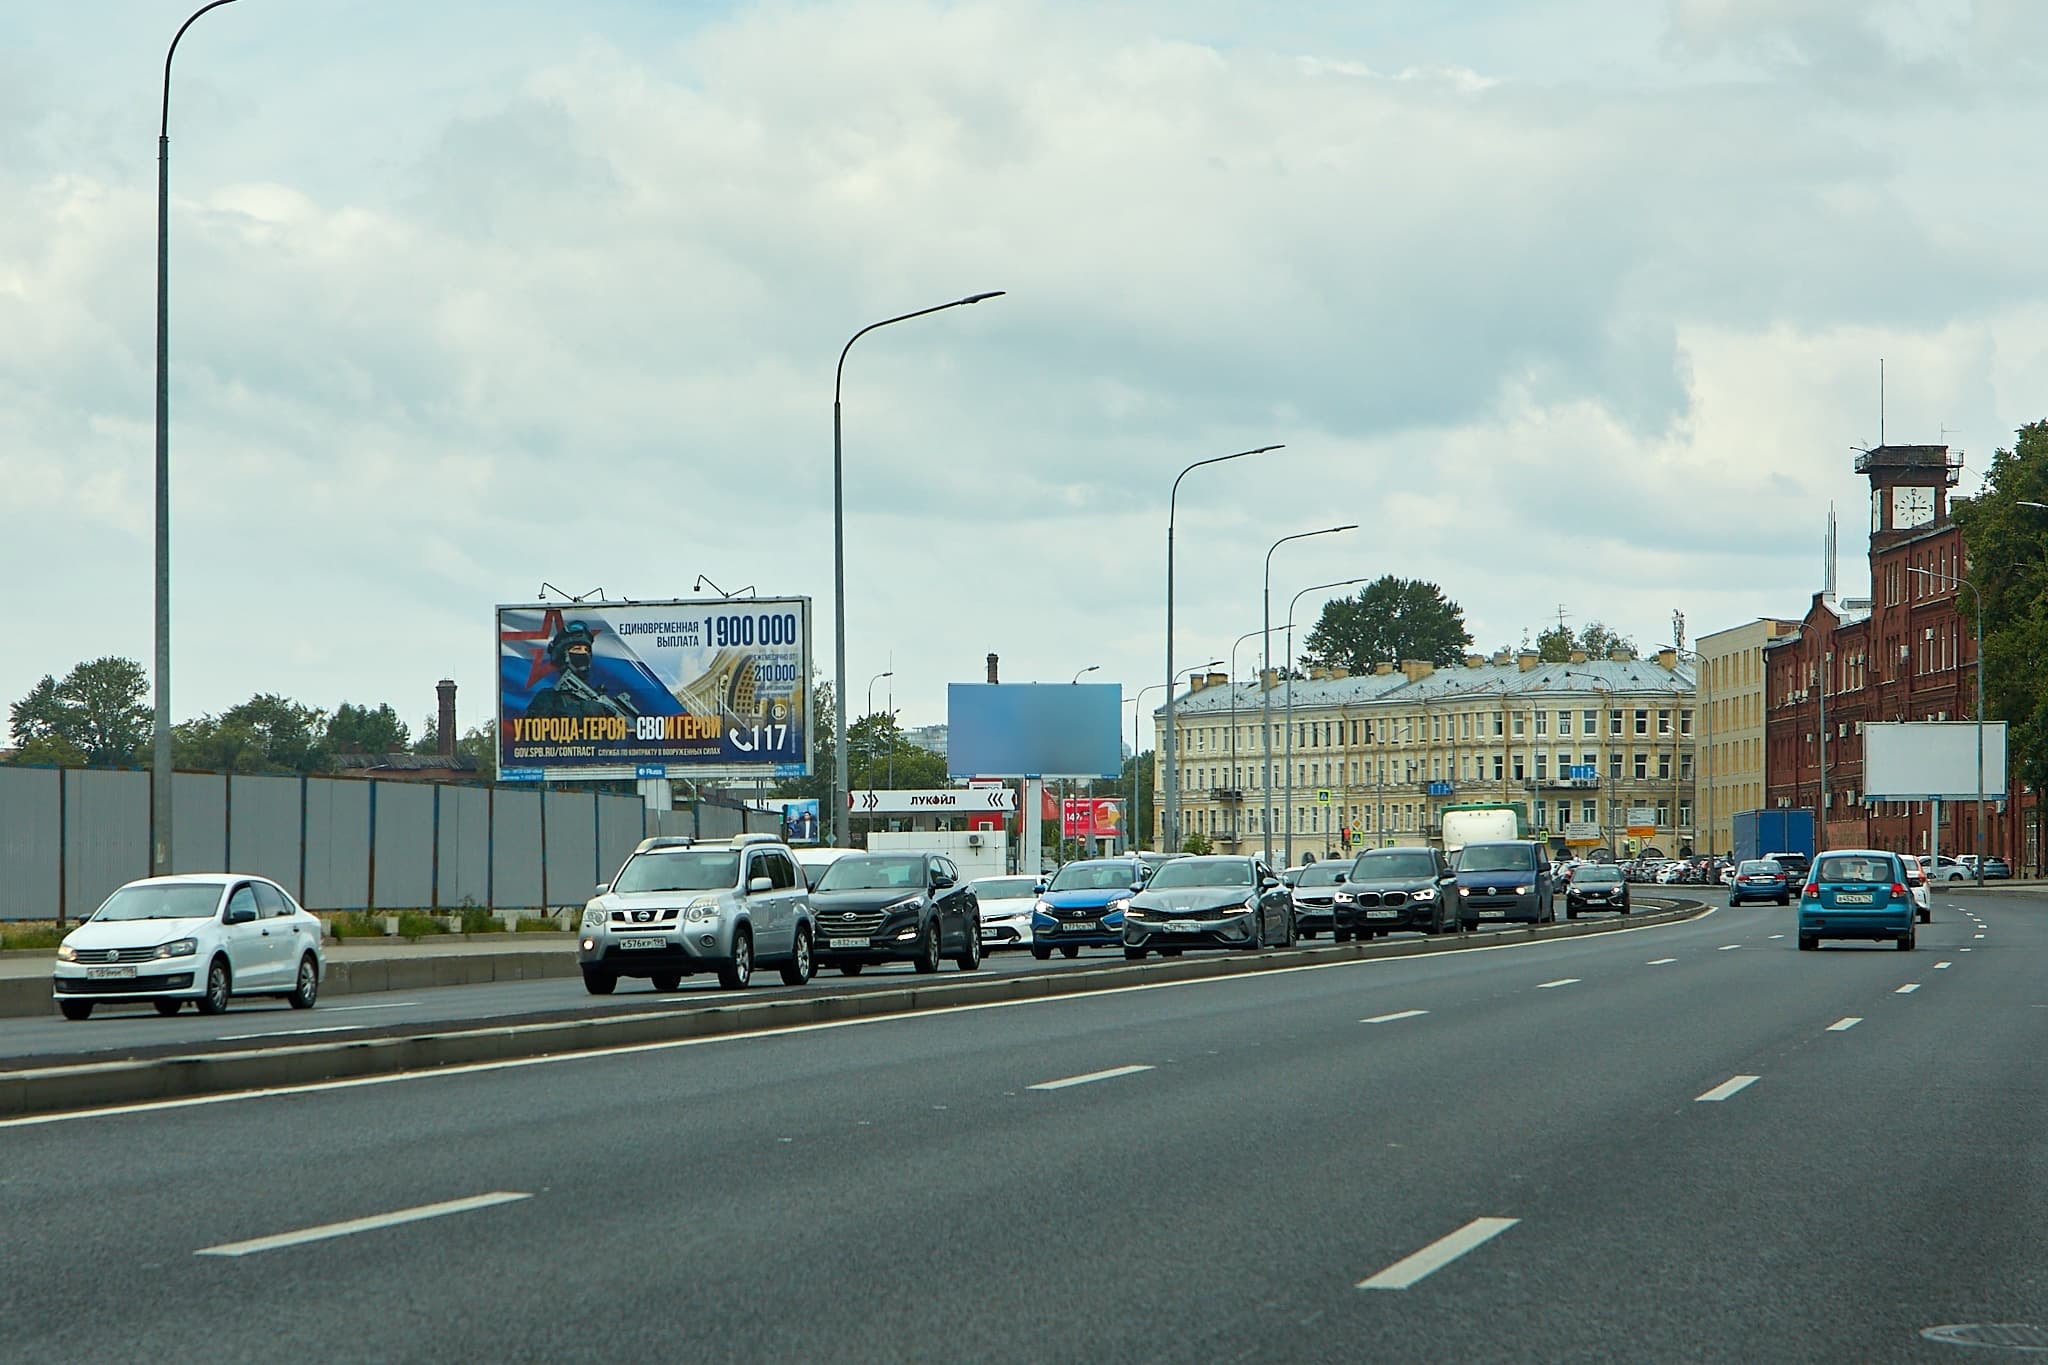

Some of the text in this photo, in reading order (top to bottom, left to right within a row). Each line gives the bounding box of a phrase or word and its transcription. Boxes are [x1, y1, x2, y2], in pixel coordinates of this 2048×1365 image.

[619, 621, 699, 636] ЕДИНОВРЕМЕННАЯ
[657, 635, 699, 648] ВЫПЛАТА
[755, 664, 796, 681] 210 000
[514, 718, 523, 742] У
[525, 716, 626, 743] ГОРОДА-ГЕРОЯ
[636, 716, 674, 740] СВОИ
[676, 716, 721, 739] ГЕРОИ
[751, 724, 787, 751] 117
[514, 746, 595, 758] GOV.SPB.RU/CONTRACT
[598, 748, 620, 756] СЛУЖБА
[628, 748, 657, 756] КОНТРАКТУ
[662, 747, 702, 756] ВООРУЖЕННЫХ
[703, 747, 721, 755] СИЛАХ
[910, 794, 956, 805] ЛУКОЙЛ
